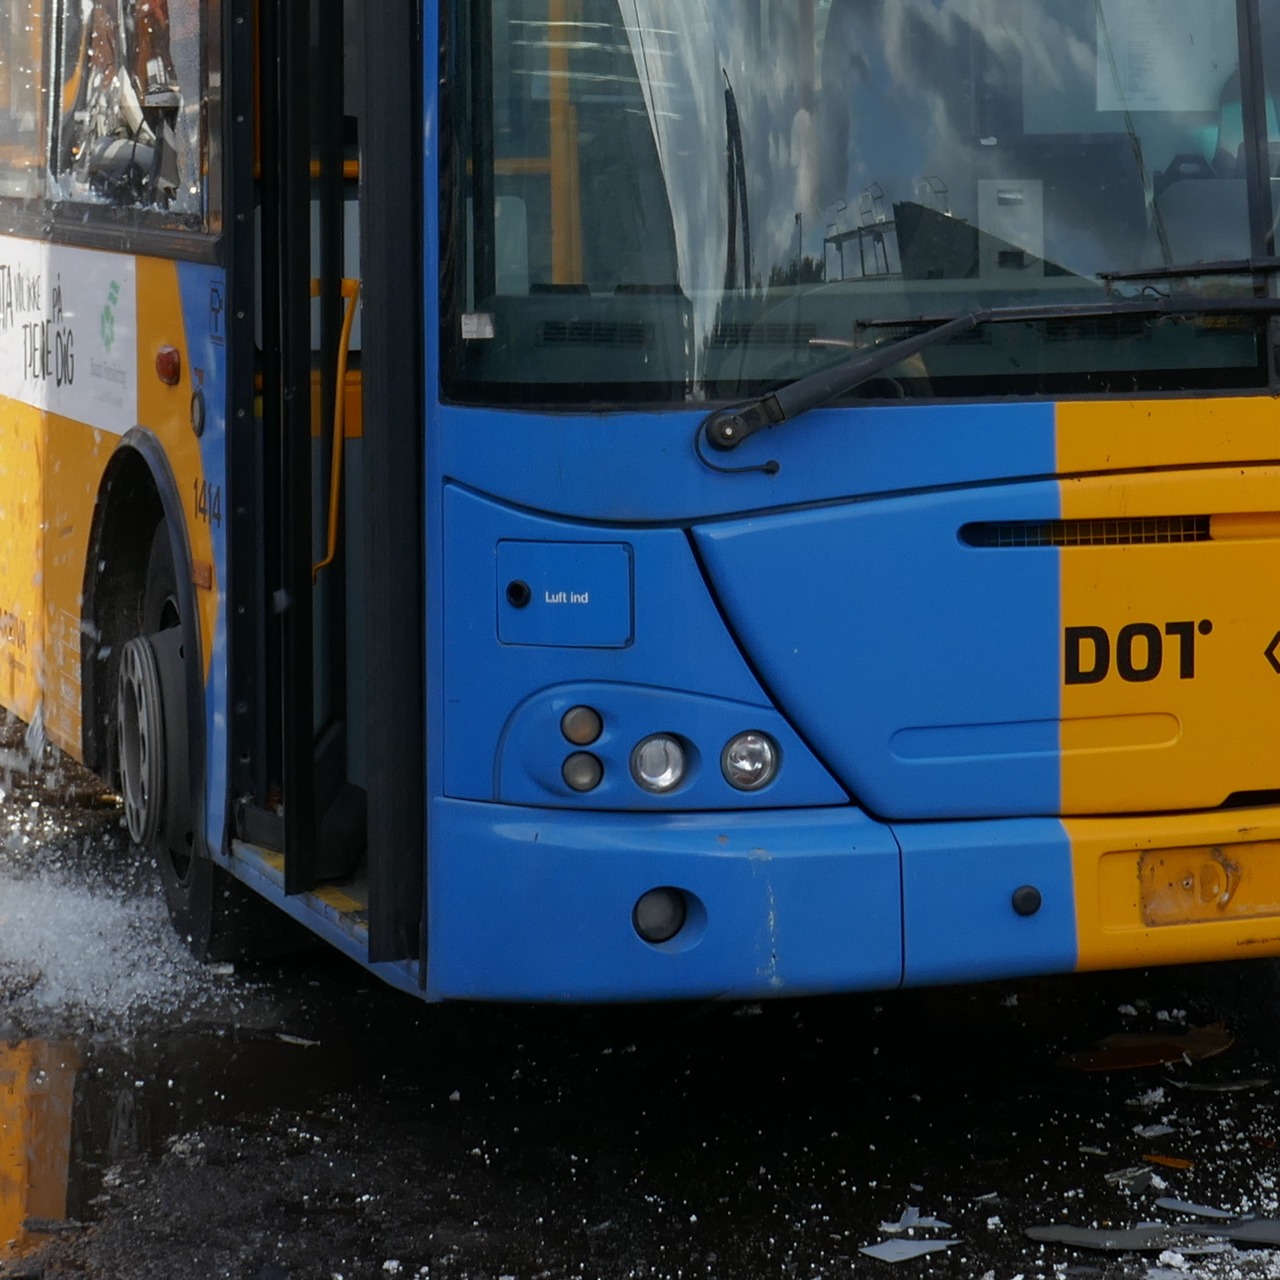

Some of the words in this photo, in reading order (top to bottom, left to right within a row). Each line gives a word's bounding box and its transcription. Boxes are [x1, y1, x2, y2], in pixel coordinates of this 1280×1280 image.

[22, 319, 53, 381] TJENE
[193, 477, 222, 529] 1414
[545, 590, 568, 604] Luft
[570, 591, 590, 604] ind
[1064, 619, 1214, 686] DOT
